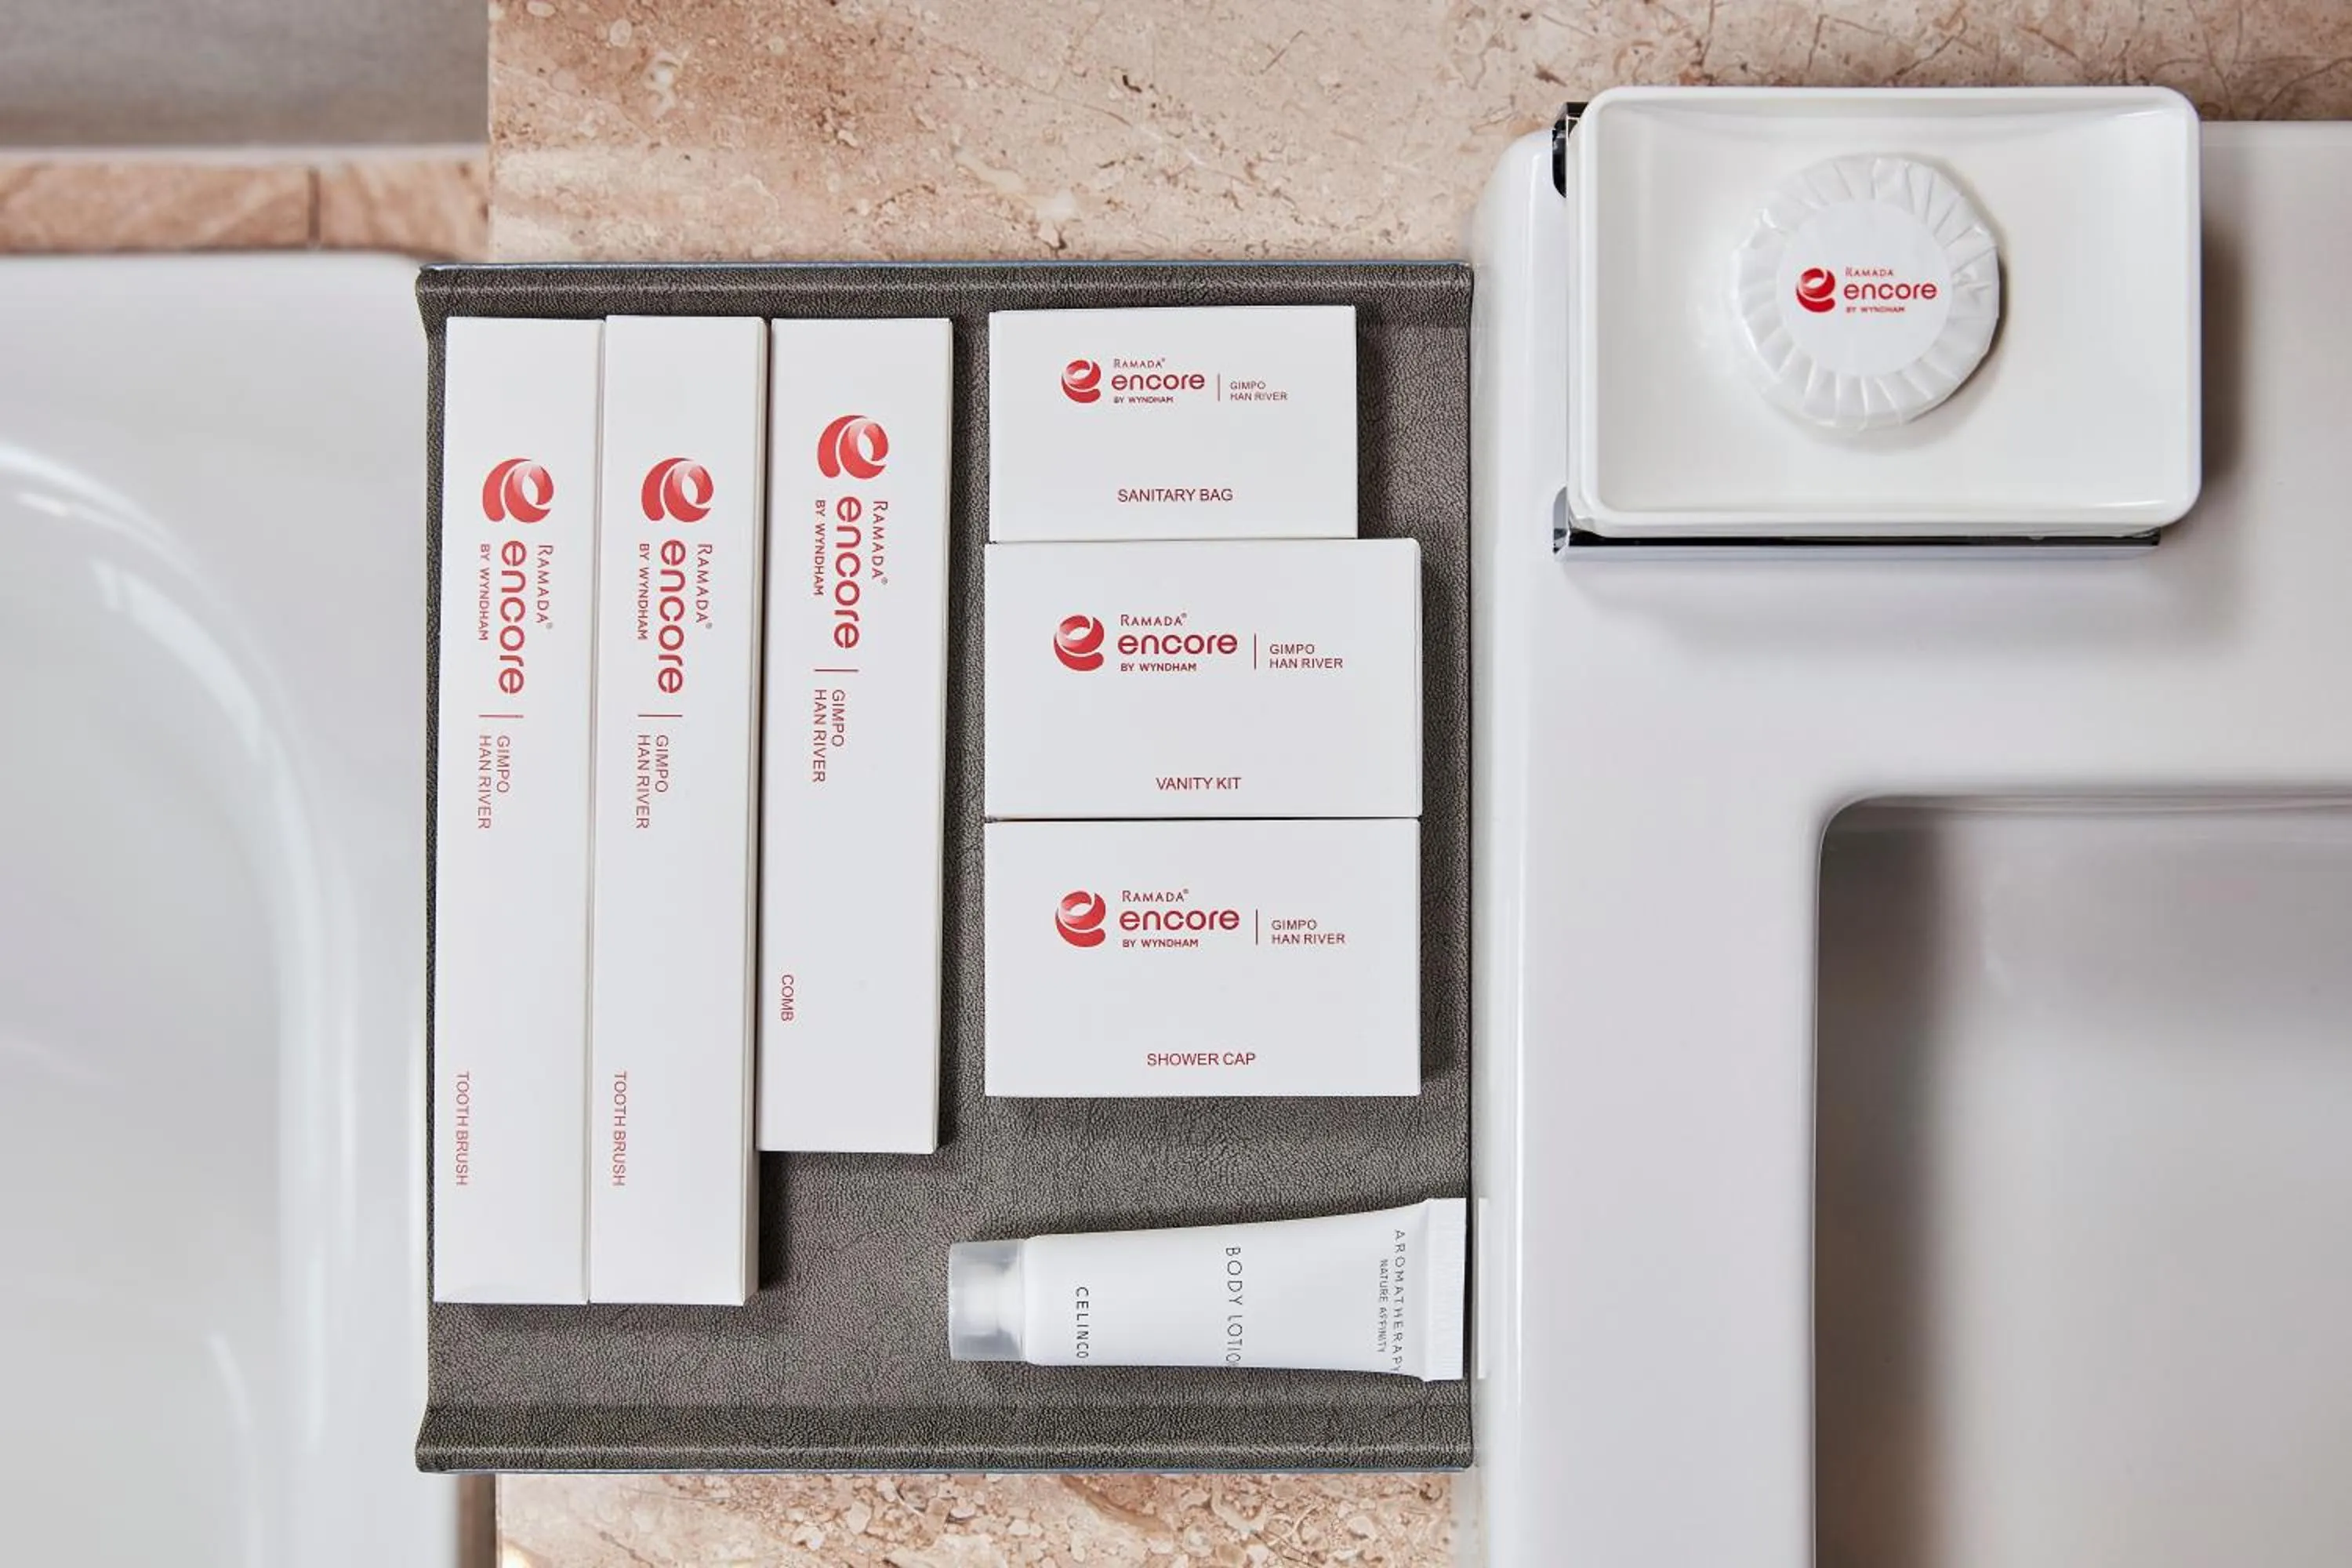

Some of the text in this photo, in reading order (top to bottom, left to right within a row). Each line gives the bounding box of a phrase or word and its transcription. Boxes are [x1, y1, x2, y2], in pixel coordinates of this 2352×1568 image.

[1843, 282, 1938, 300] encore
[1111, 374, 1205, 391] encore
[1229, 380, 1266, 390] GIMPO
[1230, 391, 1288, 401] HAN RIVER
[1117, 488, 1233, 503] SANITARY BAG
[813, 499, 826, 596] BY WYNDHAM
[833, 495, 863, 649] encore
[478, 543, 491, 641] BY WYNDHAM
[498, 539, 527, 695] encore
[637, 543, 650, 641] BY WYNDHAM
[657, 539, 686, 694] encore
[1117, 633, 1238, 655] encore
[1120, 662, 1197, 673] BY WYNDHAM
[1269, 644, 1316, 655] GIMPO
[1269, 658, 1343, 669] HAN RIVER
[812, 689, 827, 782] HAN RIVER
[830, 689, 847, 747] GIMPO
[477, 735, 492, 829] HAN RIVER
[495, 735, 510, 794] GIMPO
[636, 735, 651, 829] HAN RIVER
[655, 735, 669, 793] GIMPO
[1156, 777, 1242, 790] VANITY KIT
[1119, 909, 1240, 932] encore
[1123, 938, 1199, 949] BY WYNDHAM
[1271, 918, 1318, 931] GIMPO
[1272, 932, 1345, 945] HAN RIVER
[780, 975, 794, 1022] COMB
[1147, 1051, 1257, 1067] SHOWER CAP
[456, 1071, 470, 1185] TOOTH BRUSH
[612, 1071, 627, 1186] TOOTH BRUSH
[1225, 1246, 1243, 1305] BODY
[1075, 1287, 1090, 1359] CELINCO
[1377, 1259, 1390, 1353] NATURE AFFINITY
